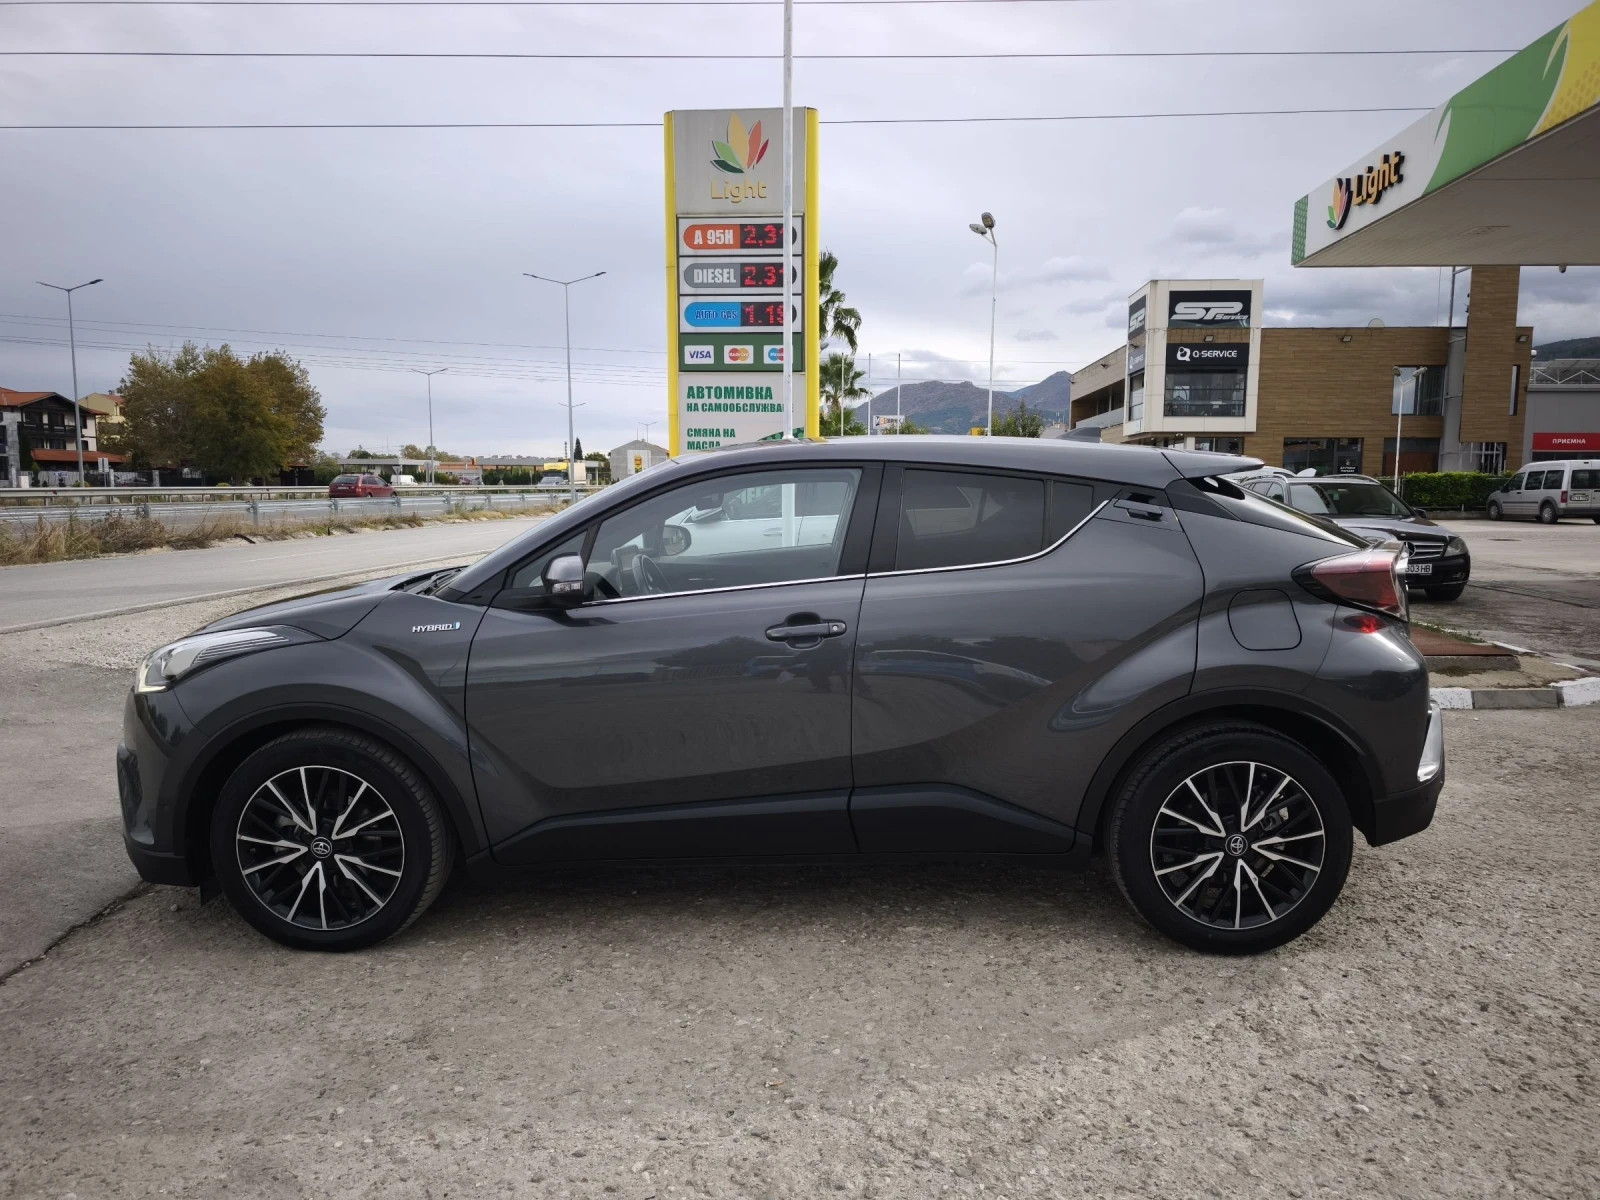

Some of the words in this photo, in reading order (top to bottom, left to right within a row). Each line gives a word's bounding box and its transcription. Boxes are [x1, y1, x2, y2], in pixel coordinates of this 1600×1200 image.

[1352, 151, 1405, 206] Light
[710, 179, 767, 203] Light
[694, 230, 703, 244] A
[707, 230, 734, 244] 95H
[694, 269, 736, 283] DIESEL
[695, 309, 718, 320] AUTO
[721, 310, 737, 320] GAS
[1170, 301, 1243, 320] SP
[688, 350, 712, 359] VISA
[686, 386, 773, 400] АВТОМИВКА
[686, 403, 699, 412] НА
[701, 403, 794, 413] САМООБСЛУЖВА
[686, 428, 721, 438] СМЯНА
[723, 428, 736, 438] НА
[1420, 564, 1431, 573] HB
[412, 624, 453, 633] HYBRID
